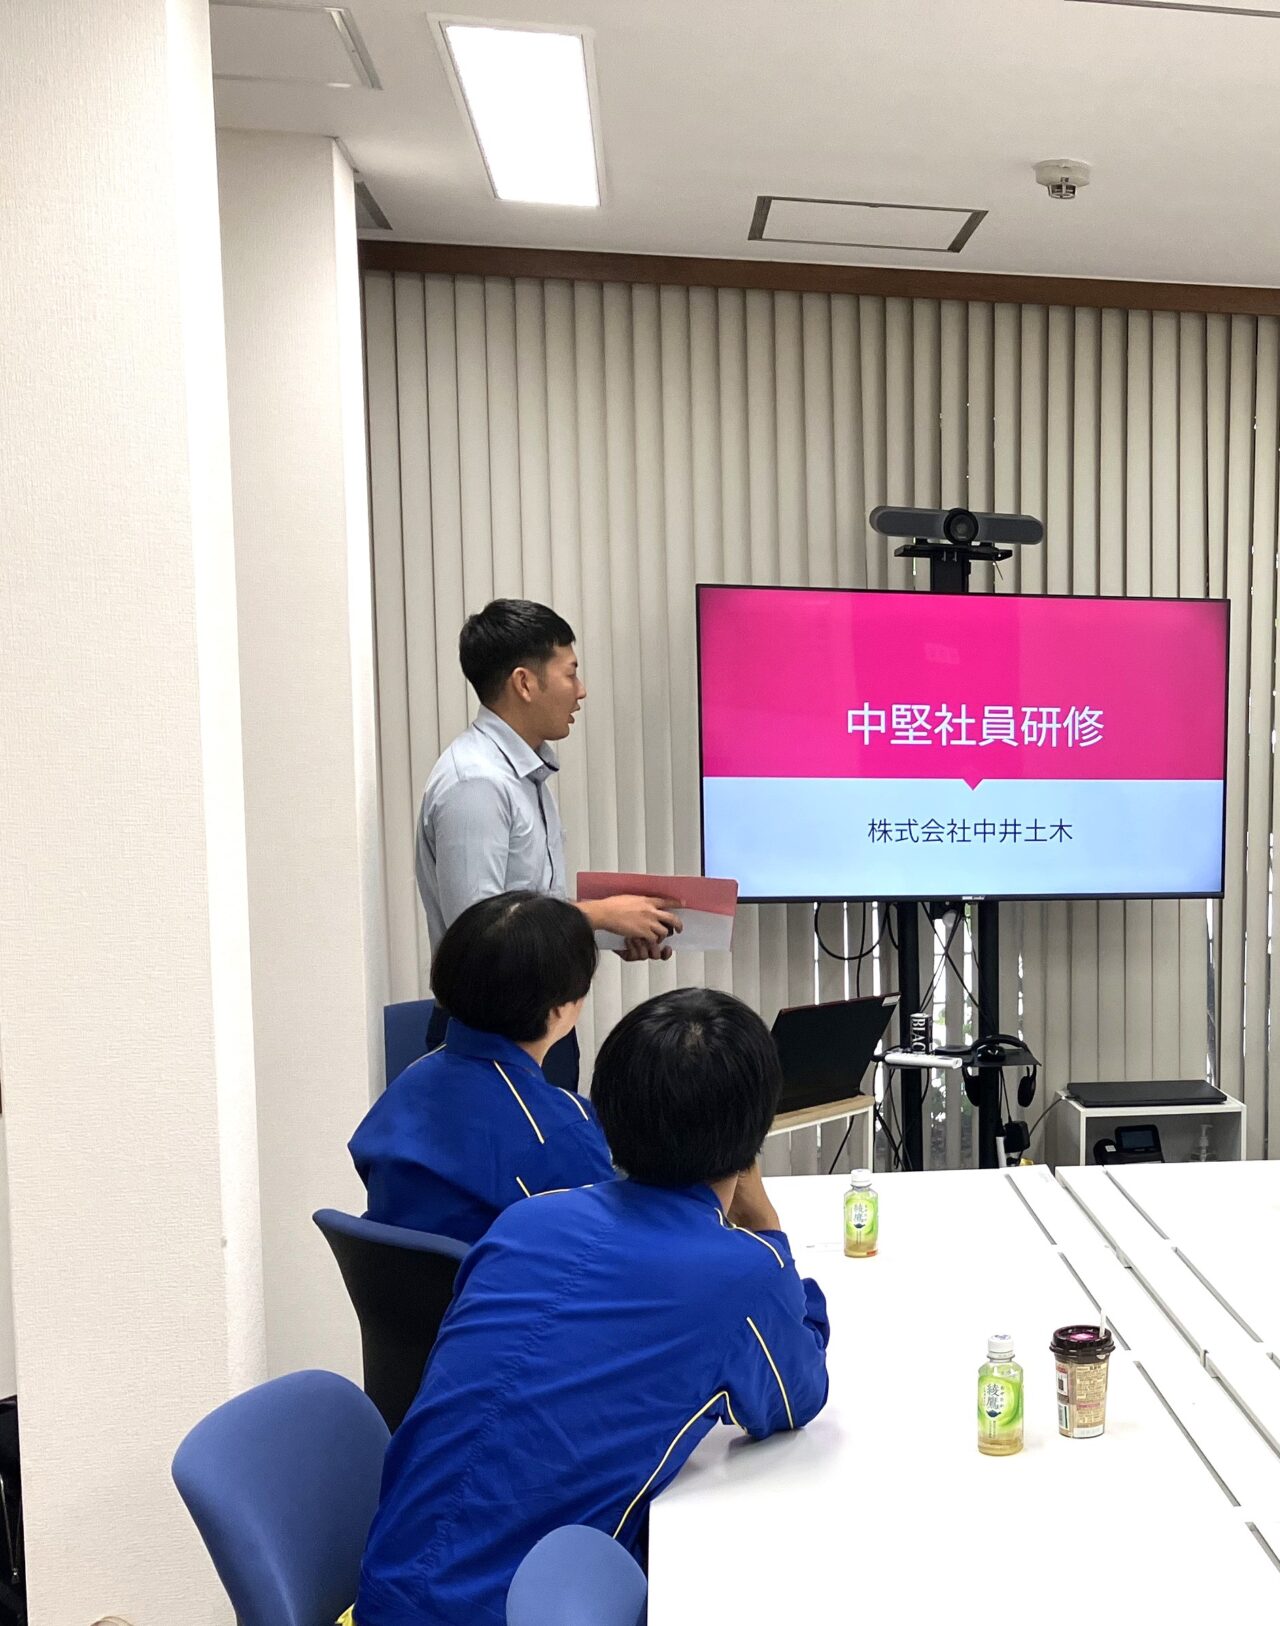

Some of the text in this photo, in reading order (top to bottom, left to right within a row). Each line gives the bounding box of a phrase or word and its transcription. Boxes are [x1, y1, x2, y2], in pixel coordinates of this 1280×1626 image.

[846, 701, 1105, 748] 中堅社員研修
[867, 817, 1074, 844] 株式会社中井土木
[911, 1018, 926, 1054] BLAC
